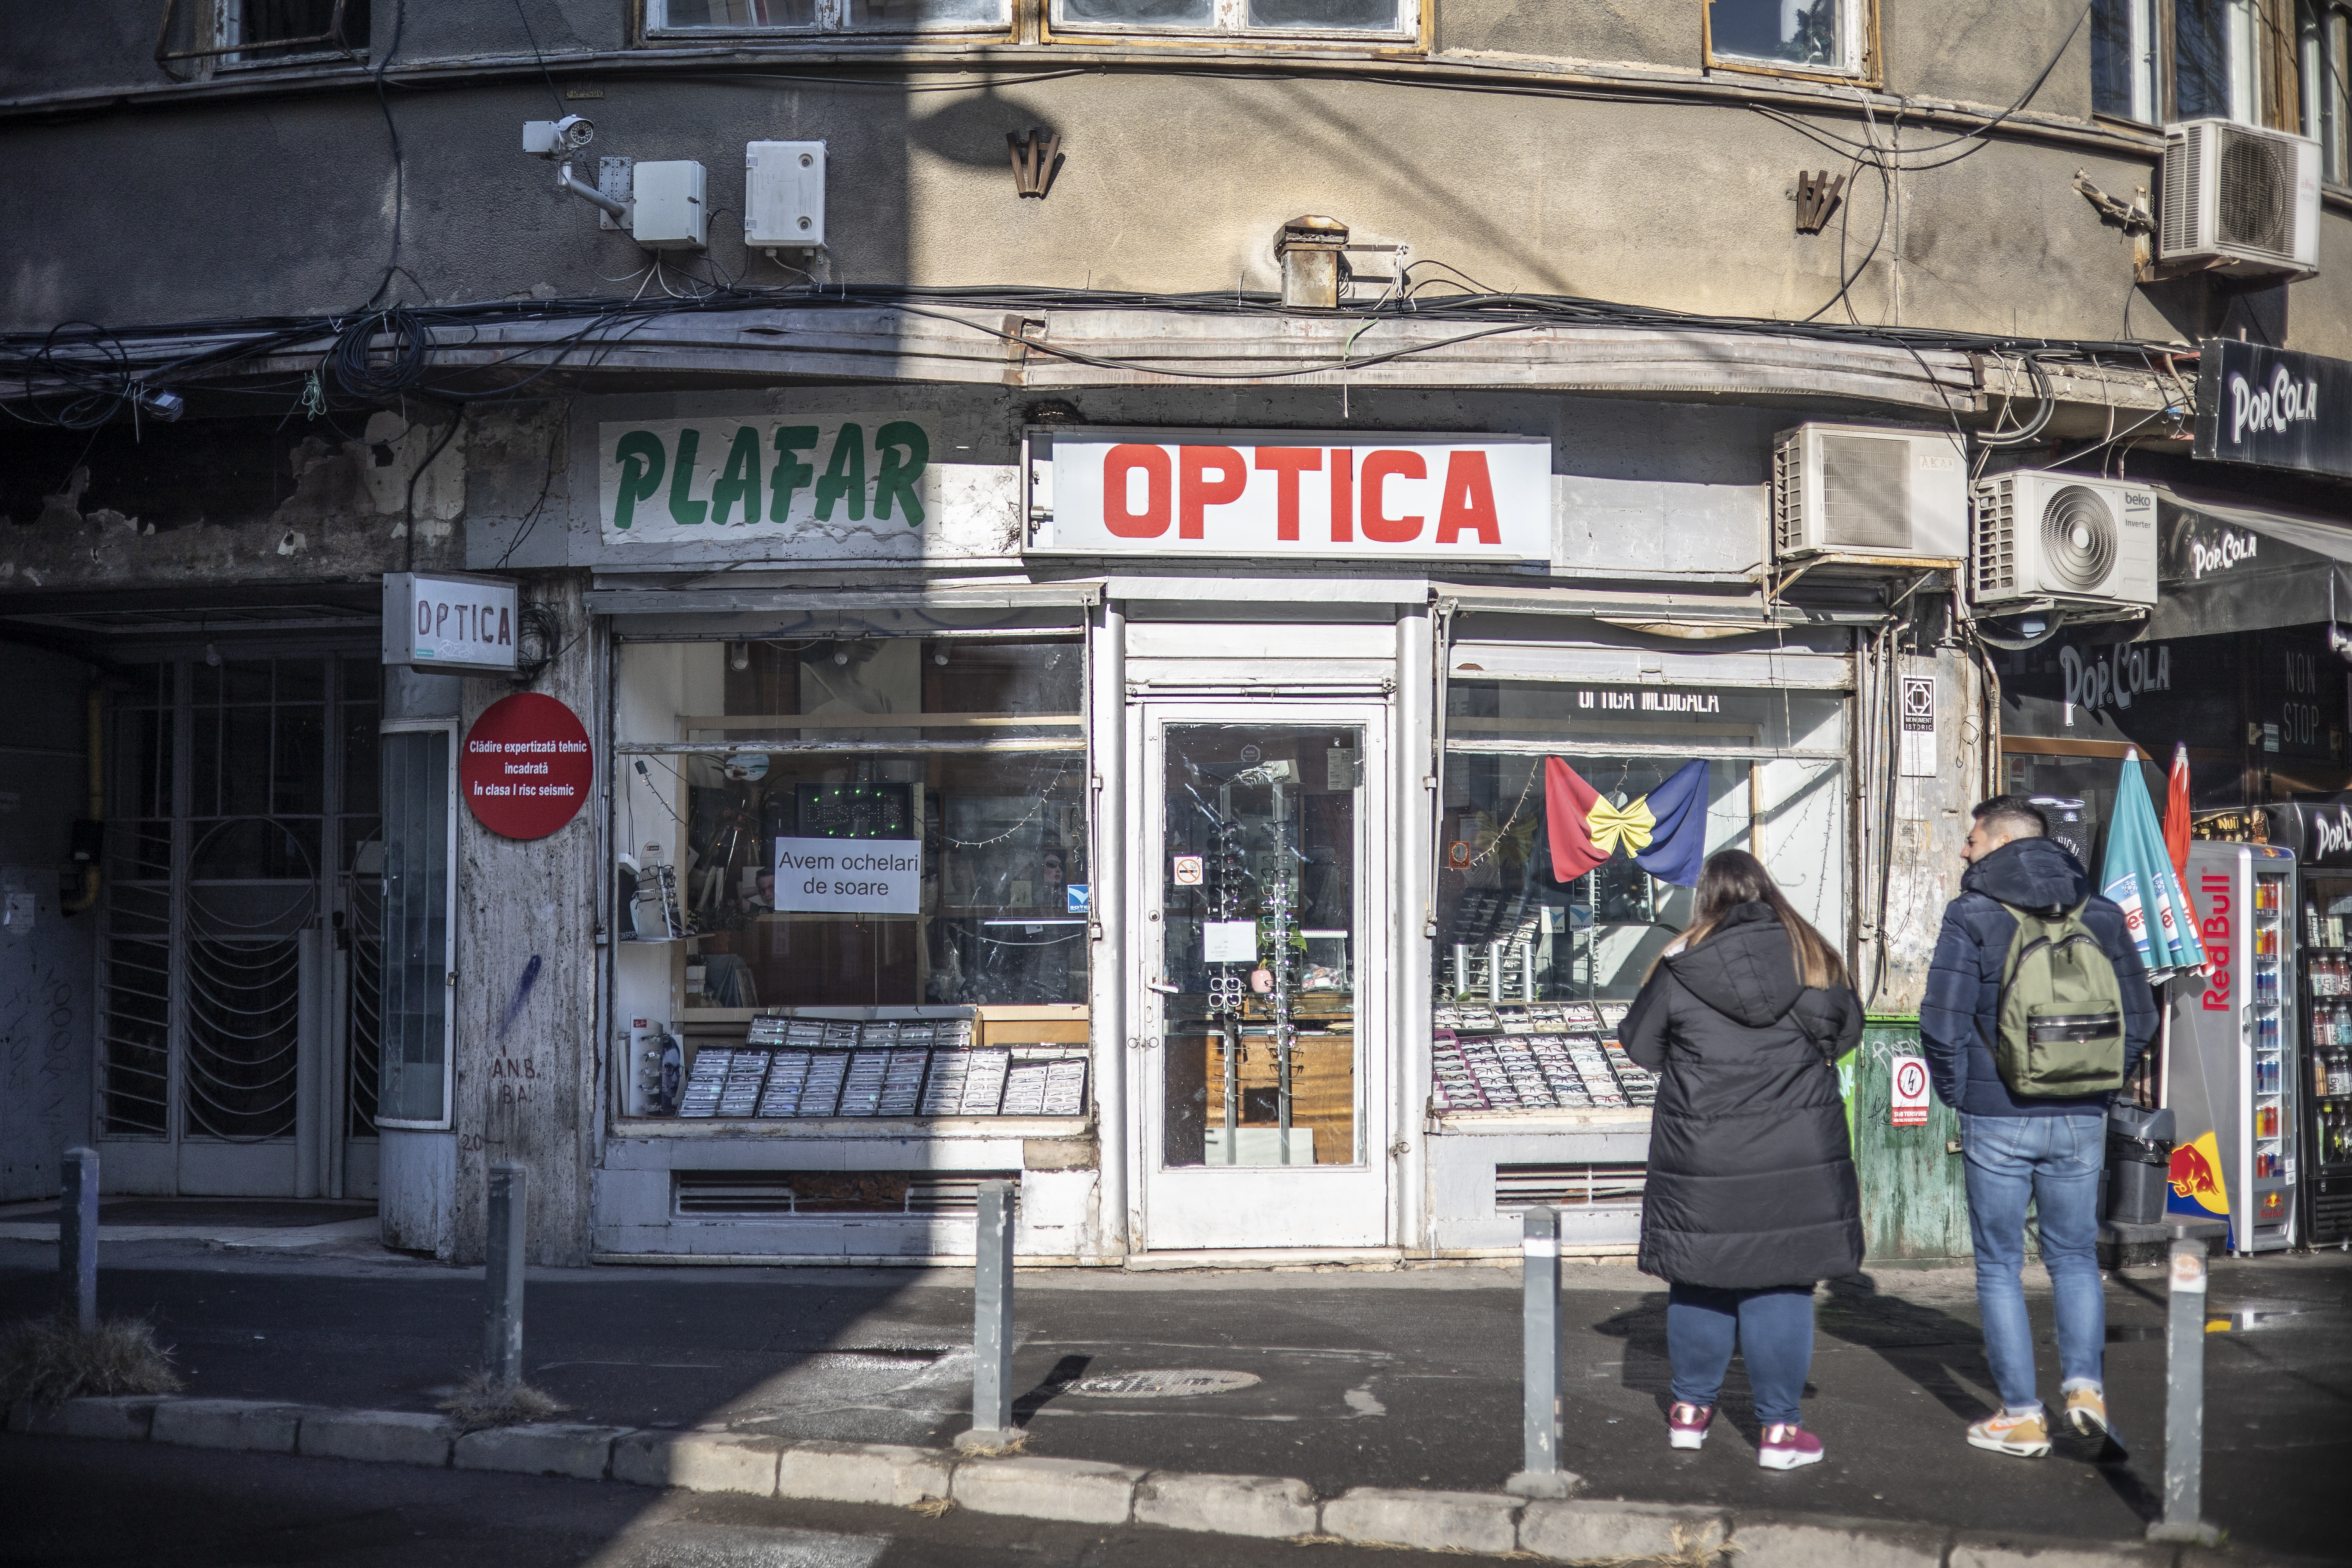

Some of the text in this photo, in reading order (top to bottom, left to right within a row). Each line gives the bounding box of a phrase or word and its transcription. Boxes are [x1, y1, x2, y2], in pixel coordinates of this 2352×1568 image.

[613, 421, 929, 529] PLAFAR
[1103, 444, 1501, 544] OPTICA
[2125, 492, 2150, 506] beko
[2125, 519, 2151, 528] Inverter
[418, 600, 511, 645] OPTICA
[2286, 651, 2315, 695] NON
[2284, 702, 2319, 745] STOP
[470, 740, 587, 755] Clădire expertizată tehnic
[505, 762, 548, 774] încadrată
[474, 781, 574, 796] În clasa I risc seismic
[779, 851, 918, 871] Avem ochelari
[803, 877, 888, 896] de soare
[2202, 876, 2230, 1011] Red Bull
[2261, 1208, 2284, 1219] Red Bull
